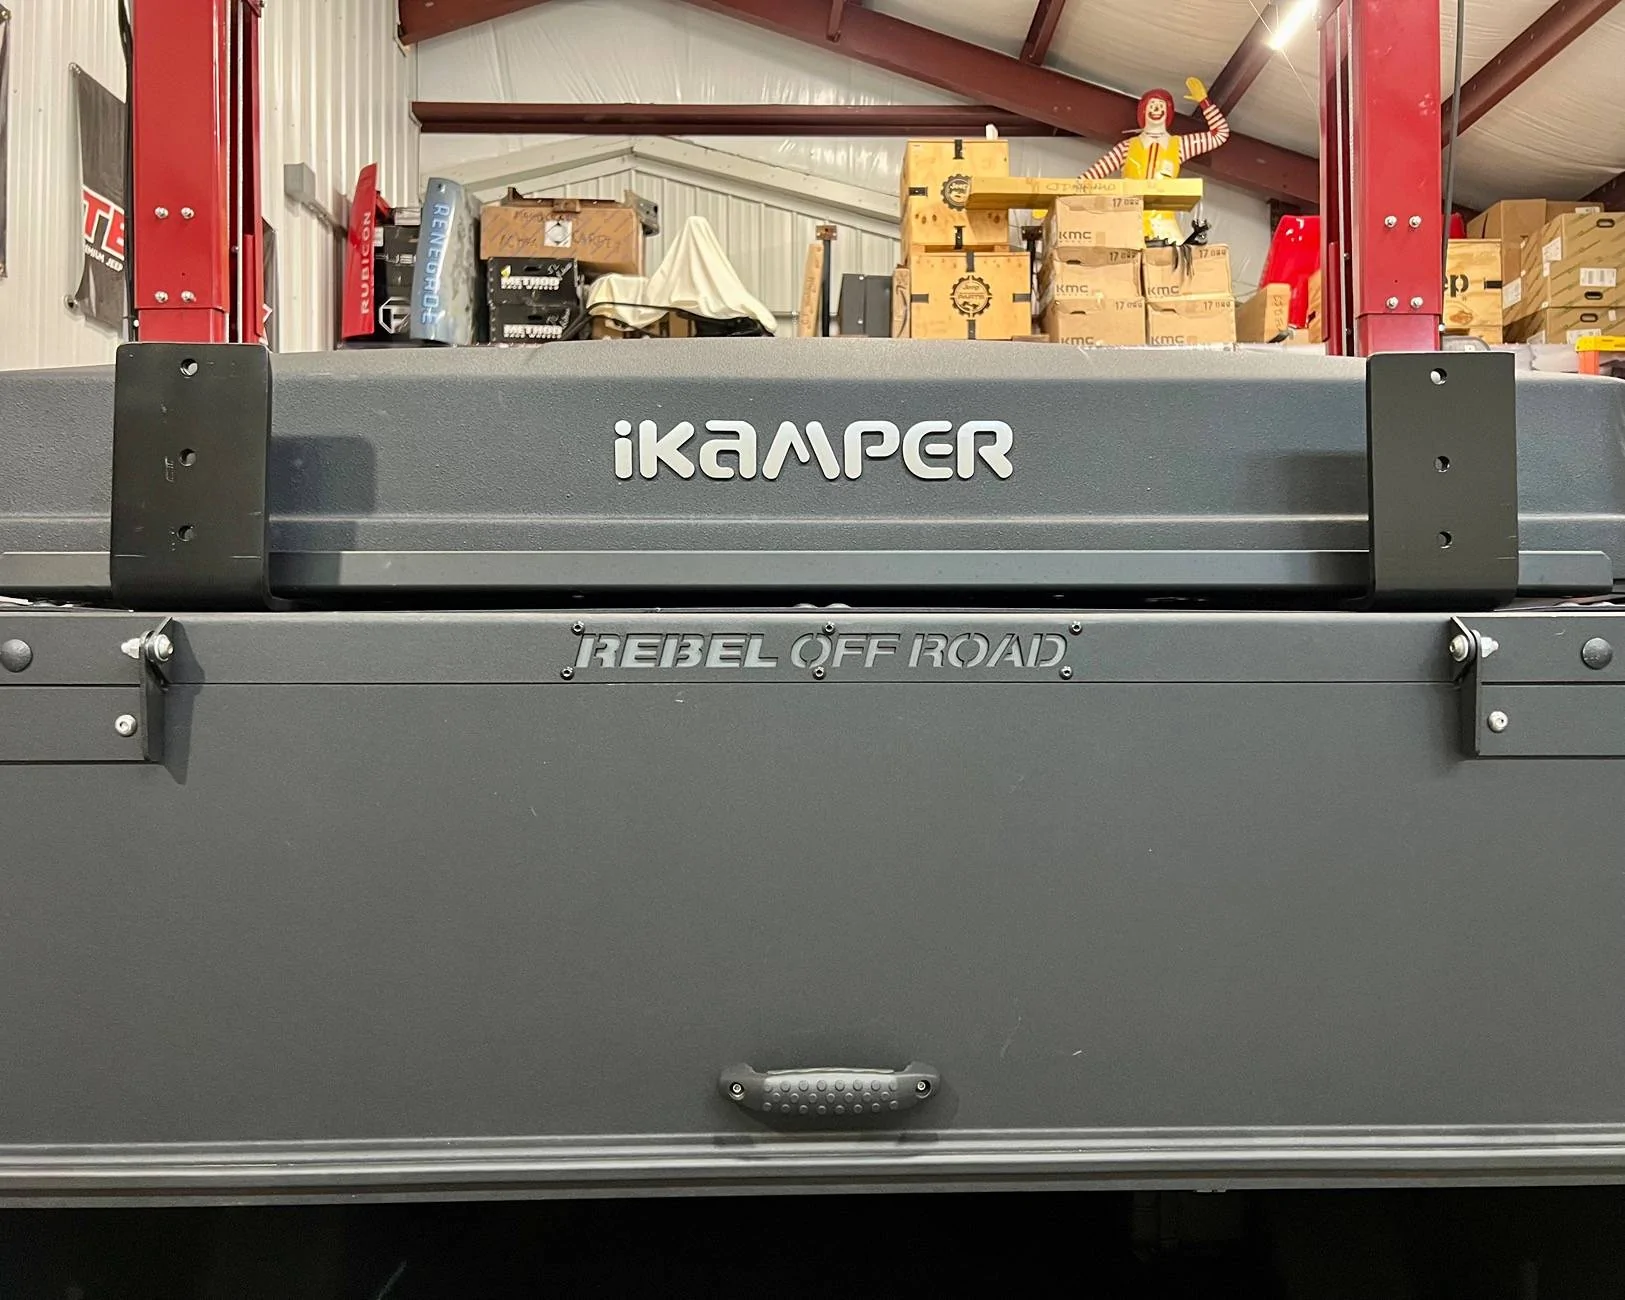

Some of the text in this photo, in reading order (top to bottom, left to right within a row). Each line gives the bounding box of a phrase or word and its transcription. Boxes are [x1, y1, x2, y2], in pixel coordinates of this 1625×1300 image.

[1112, 198, 1122, 208] 17
[1109, 251, 1119, 261] 17
[1199, 249, 1209, 259] 17
[361, 212, 372, 315] RUBICON
[1115, 301, 1125, 311] 17
[1203, 300, 1213, 311] 17
[503, 324, 562, 335] METHOD
[575, 632, 1068, 669] REBEL OFF ROAD
